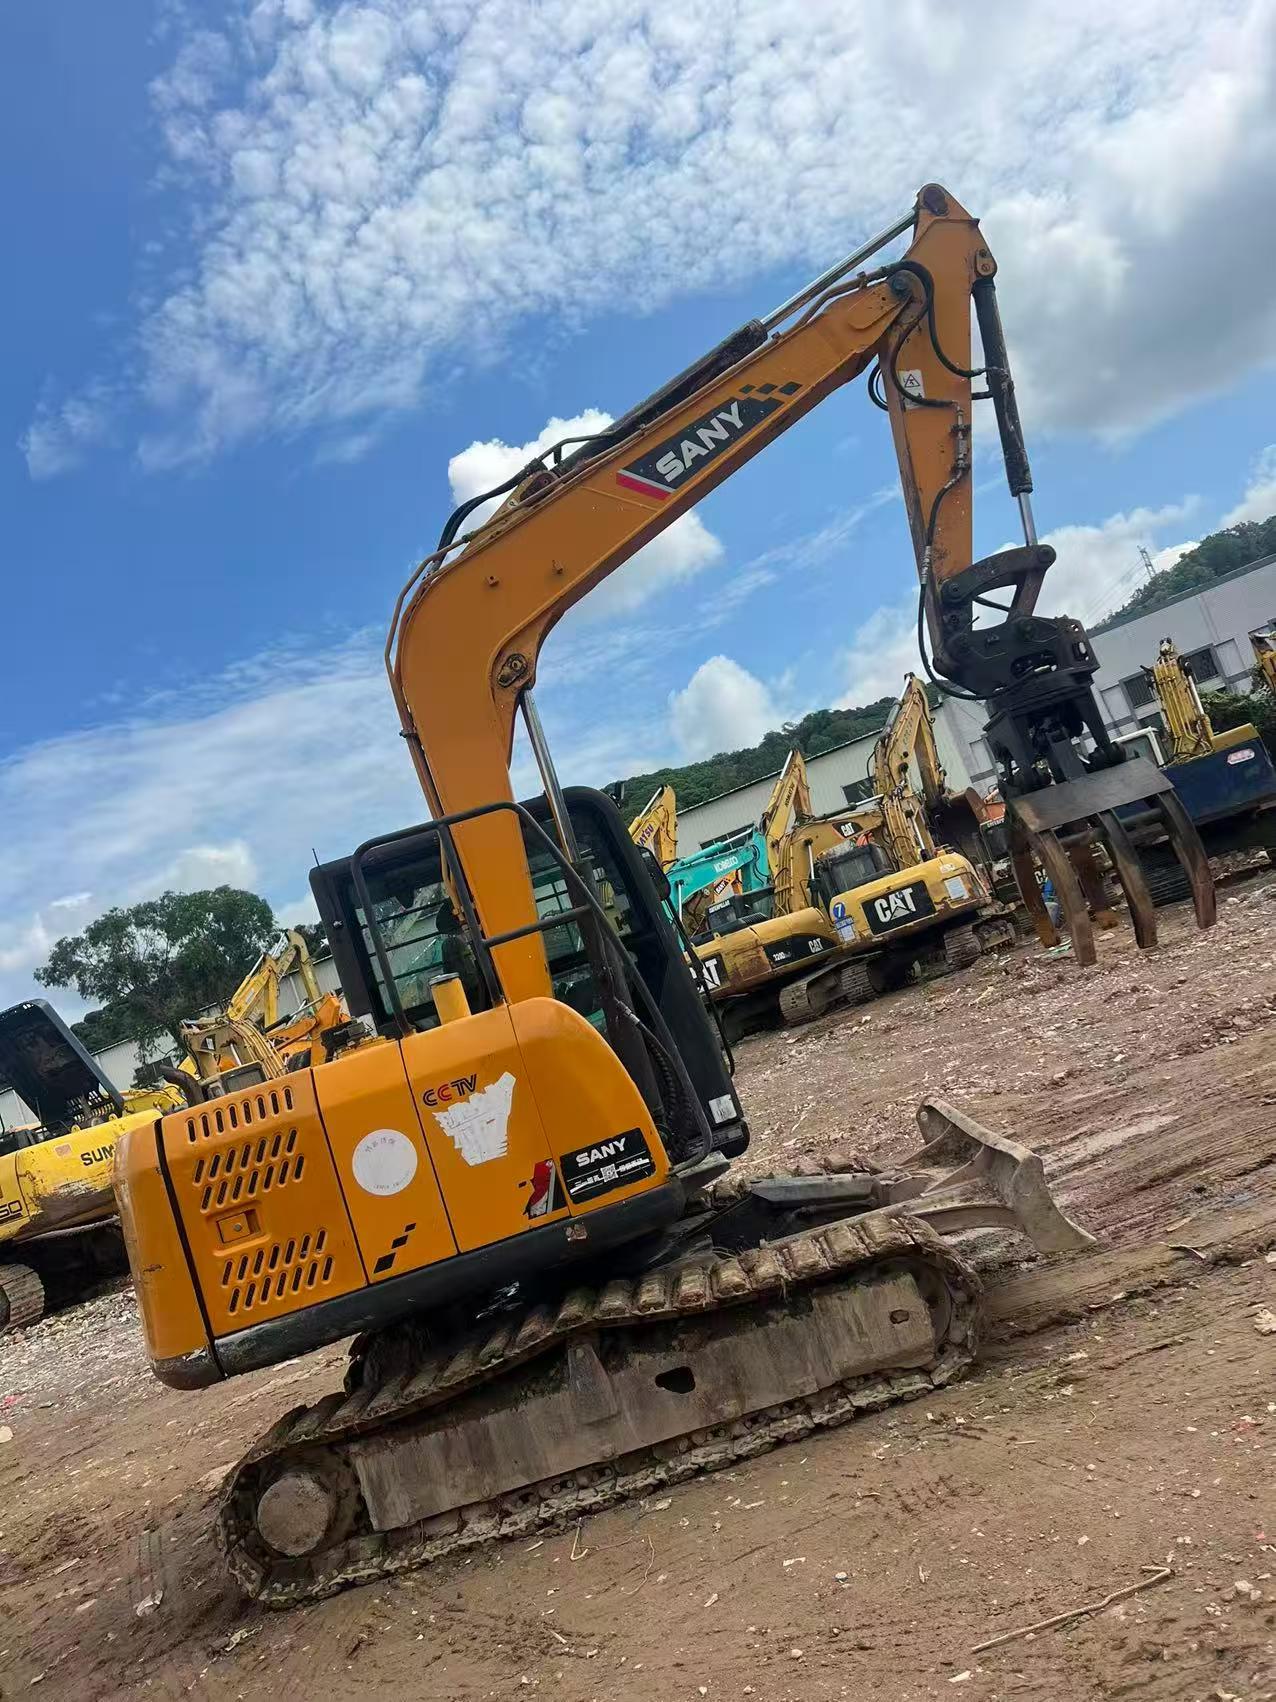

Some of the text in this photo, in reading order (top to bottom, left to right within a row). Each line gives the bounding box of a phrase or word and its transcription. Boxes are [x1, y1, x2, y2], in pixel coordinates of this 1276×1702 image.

[655, 401, 744, 483] SANY
[636, 823, 655, 847] ATSU
[840, 822, 855, 837] CAT
[835, 904, 843, 918] 7
[874, 887, 917, 923] CAT
[808, 938, 824, 954] CAT
[422, 1073, 477, 1107] CCTV
[575, 1137, 626, 1168] SANY
